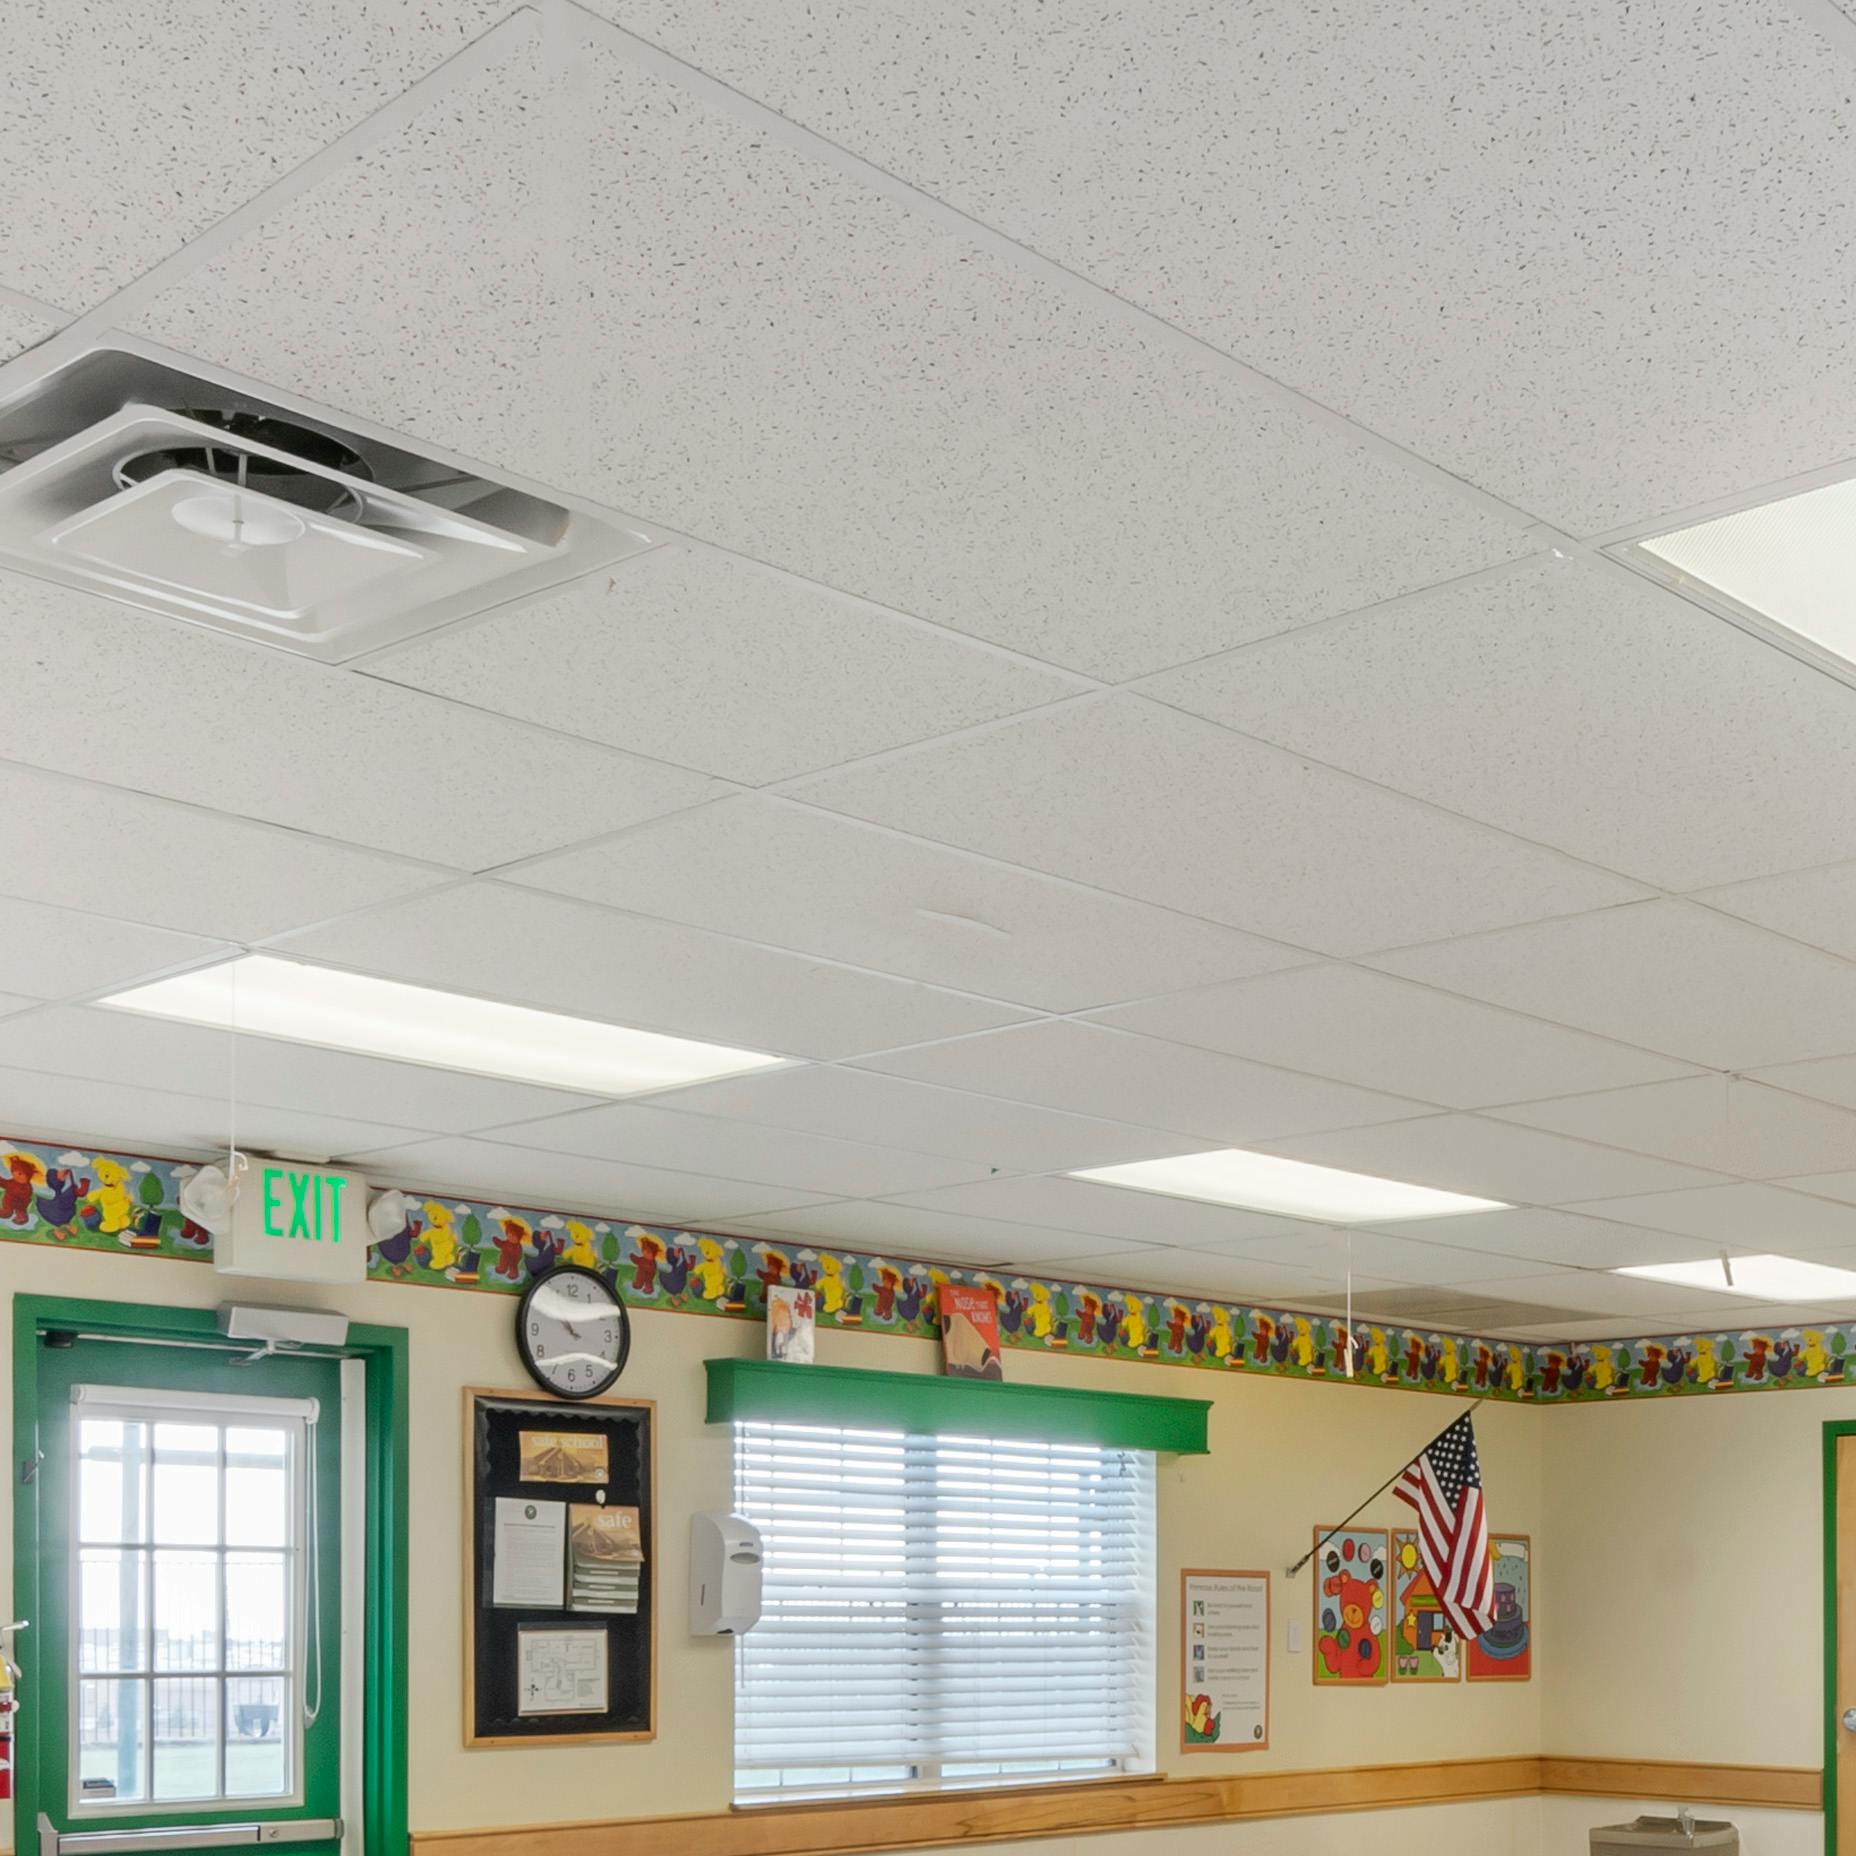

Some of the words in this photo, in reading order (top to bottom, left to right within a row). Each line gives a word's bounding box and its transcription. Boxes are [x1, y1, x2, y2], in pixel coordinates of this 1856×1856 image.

[263, 1168, 347, 1244] EXIT
[567, 1284, 579, 1297] 12
[531, 1323, 539, 1336] 9
[604, 1330, 612, 1343] 3
[536, 1344, 545, 1358] 8
[567, 1369, 576, 1382] 6
[585, 1364, 594, 1378] 5
[598, 1510, 632, 1529] safe
